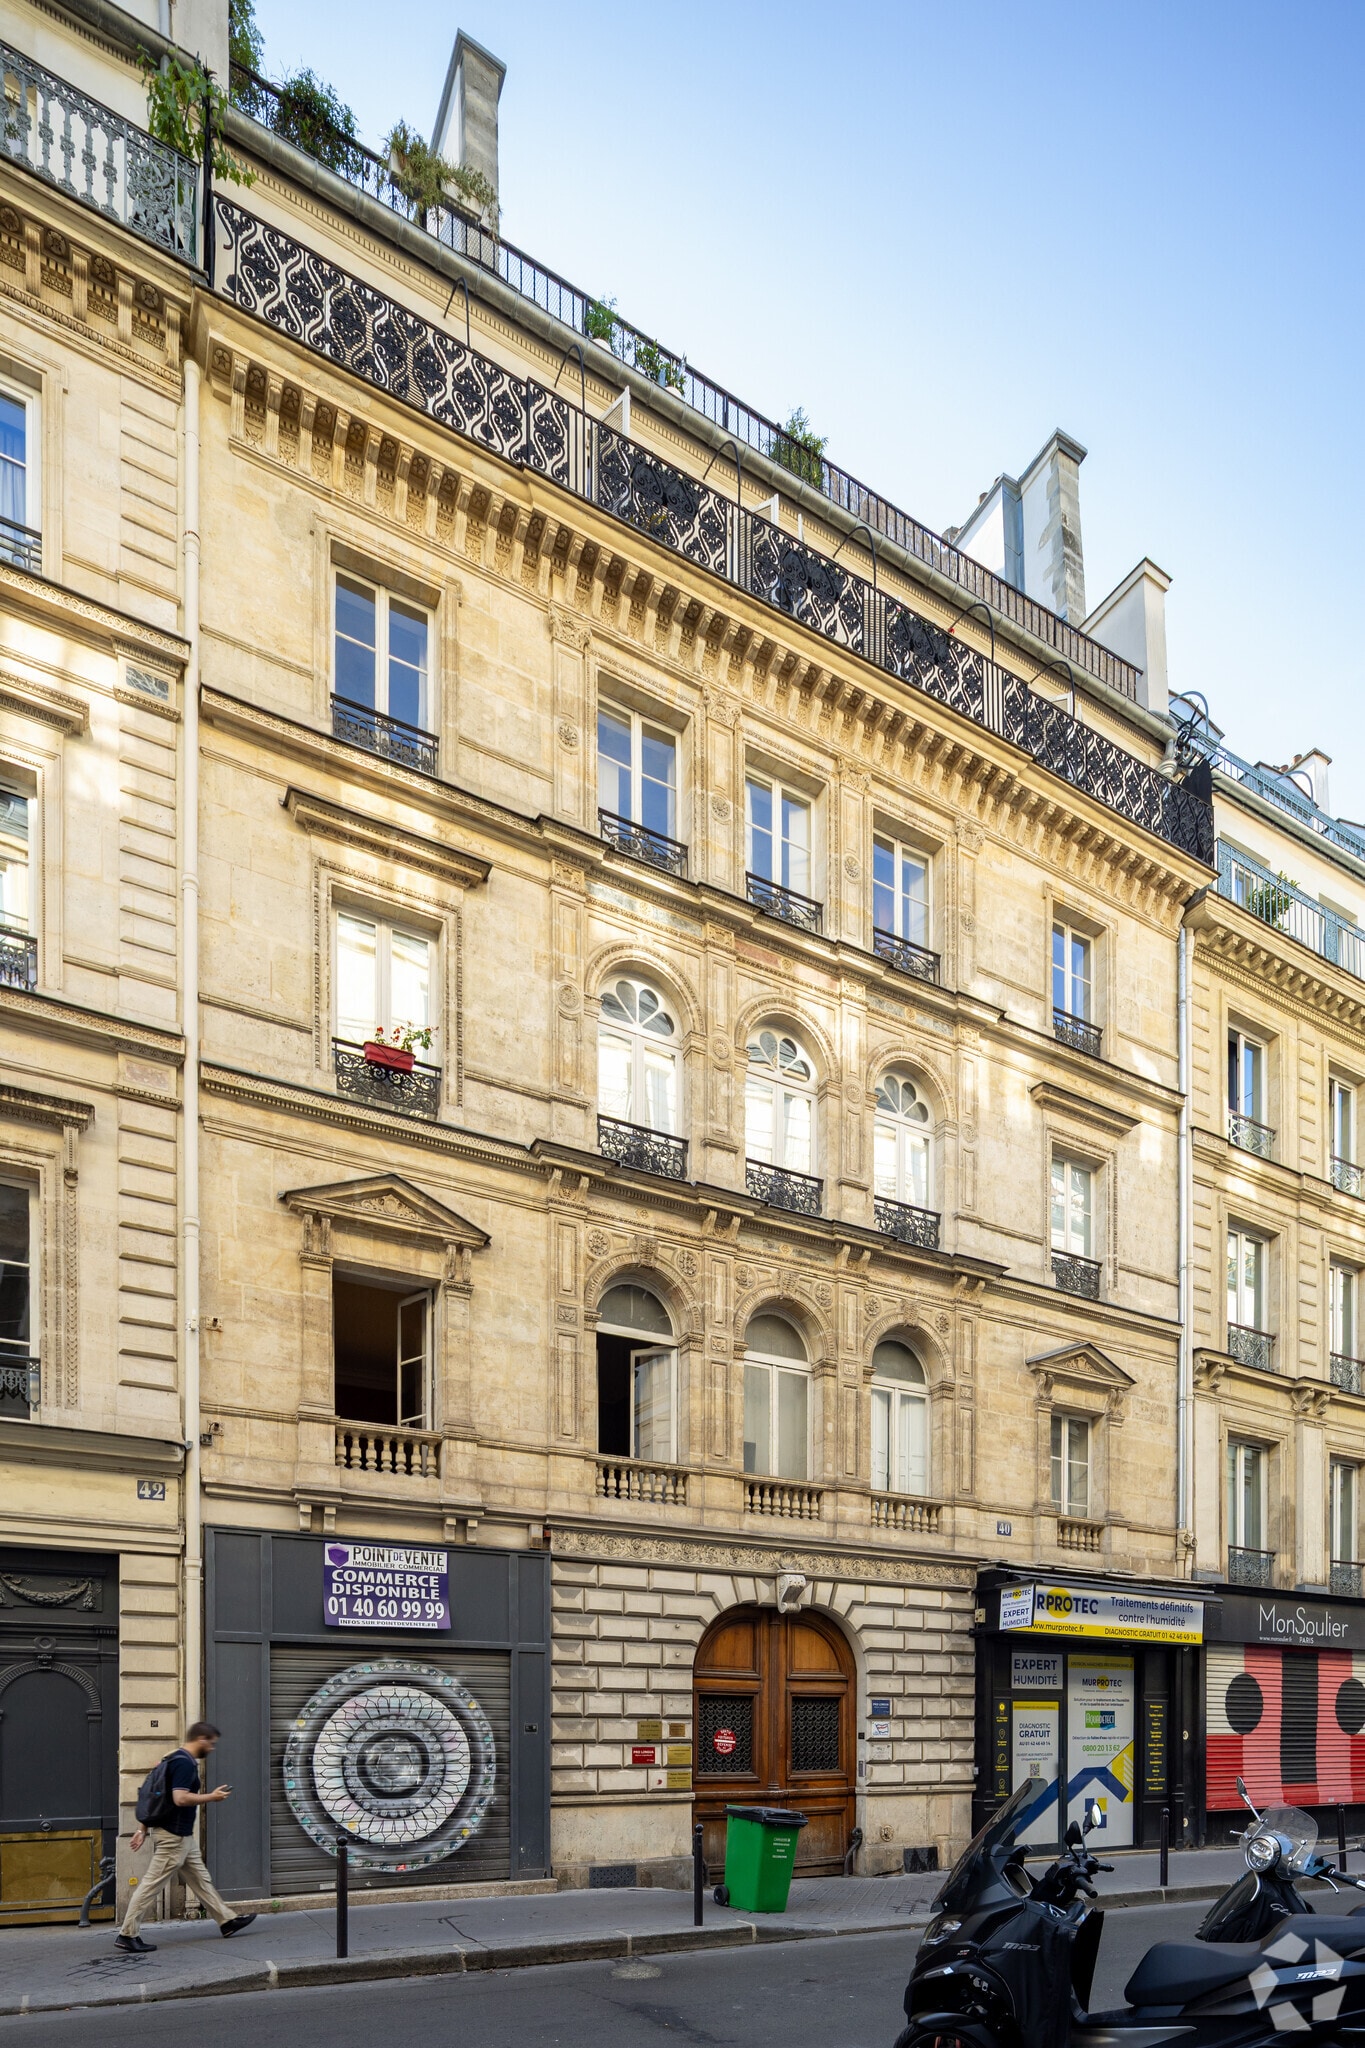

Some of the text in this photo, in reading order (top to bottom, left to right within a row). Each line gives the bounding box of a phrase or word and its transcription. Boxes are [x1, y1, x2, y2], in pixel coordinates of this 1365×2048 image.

[138, 1481, 164, 1499] 42
[998, 1522, 1010, 1535] 40
[352, 1560, 445, 1573] IMMOBILIER COMMERCIAL
[331, 1569, 440, 1588] COMMERCE
[331, 1582, 440, 1600] DISPONIBLE
[1002, 1589, 1031, 1599] MURPROTEC
[327, 1596, 445, 1620] 01 40 60 99 99
[1036, 1593, 1099, 1615] RPROTEC
[1110, 1596, 1194, 1613] Traitements définitifs
[1003, 1607, 1029, 1618] EXPERT
[1002, 1616, 1029, 1627] HUMIDITÉ
[1118, 1613, 1186, 1627] contre l'humidité
[1104, 1628, 1137, 1637] DIAGNOSTIC
[1299, 1636, 1314, 1644] PARIS
[1014, 1659, 1057, 1670] EXPERT
[1013, 1673, 1058, 1686] HUMIDITÉ
[1082, 1678, 1122, 1687] MURPROTEC
[1019, 1730, 1050, 1738] GRATUIT
[1082, 1744, 1097, 1752] 0800
[1097, 1744, 1104, 1752] 20
[1113, 1744, 1120, 1752] 62
[1002, 1942, 1040, 1951] MP3
[1295, 1968, 1337, 1980] MP3
